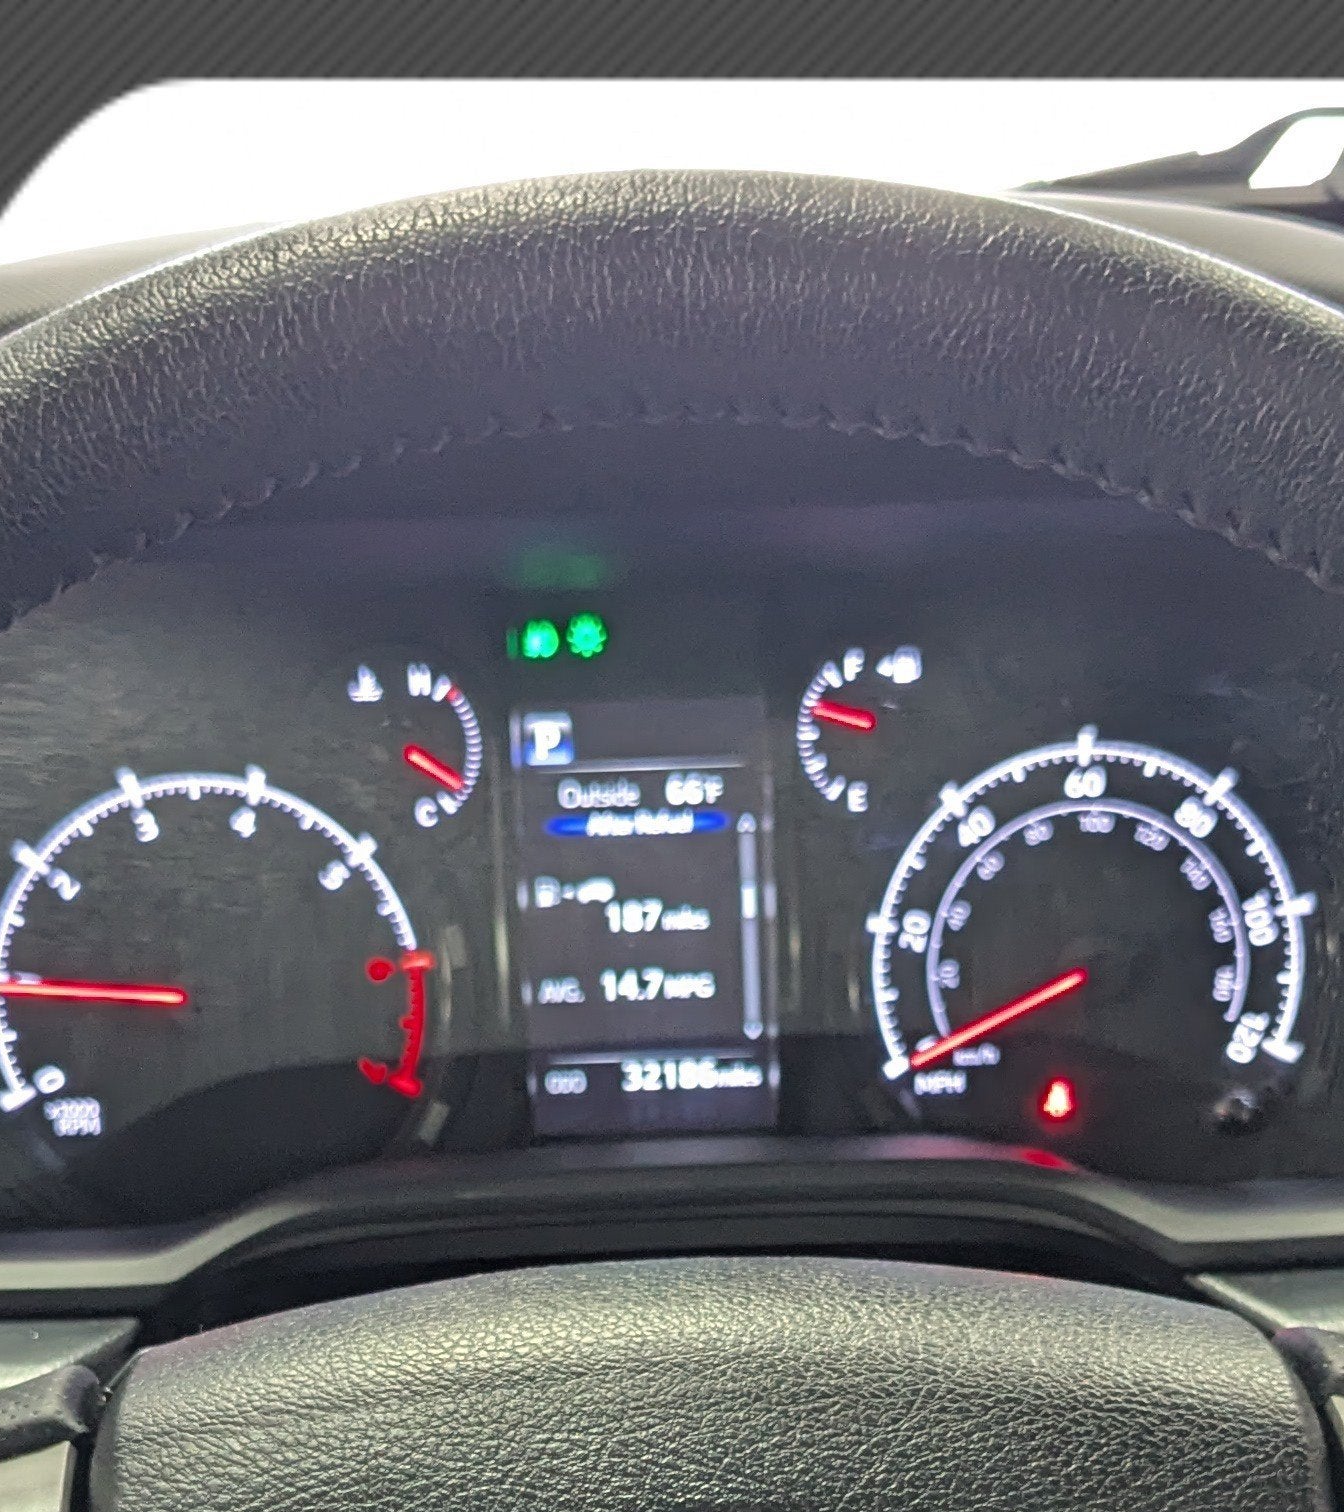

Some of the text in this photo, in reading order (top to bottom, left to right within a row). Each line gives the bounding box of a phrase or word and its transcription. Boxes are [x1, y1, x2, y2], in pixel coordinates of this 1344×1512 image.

[408, 664, 432, 697] H
[843, 646, 865, 682] F
[1063, 765, 1107, 800] 60
[133, 811, 159, 842] 3
[229, 808, 256, 837] 4
[414, 797, 439, 828] C
[957, 805, 997, 848] 40
[1173, 796, 1219, 840] 80
[50, 868, 82, 903] 2
[318, 860, 350, 891] 5
[605, 898, 663, 933] 187
[898, 908, 932, 954] 20
[1241, 888, 1279, 946] 100
[600, 967, 664, 1002] 14.7
[1226, 1011, 1270, 1064] 120
[33, 1065, 65, 1093] 0
